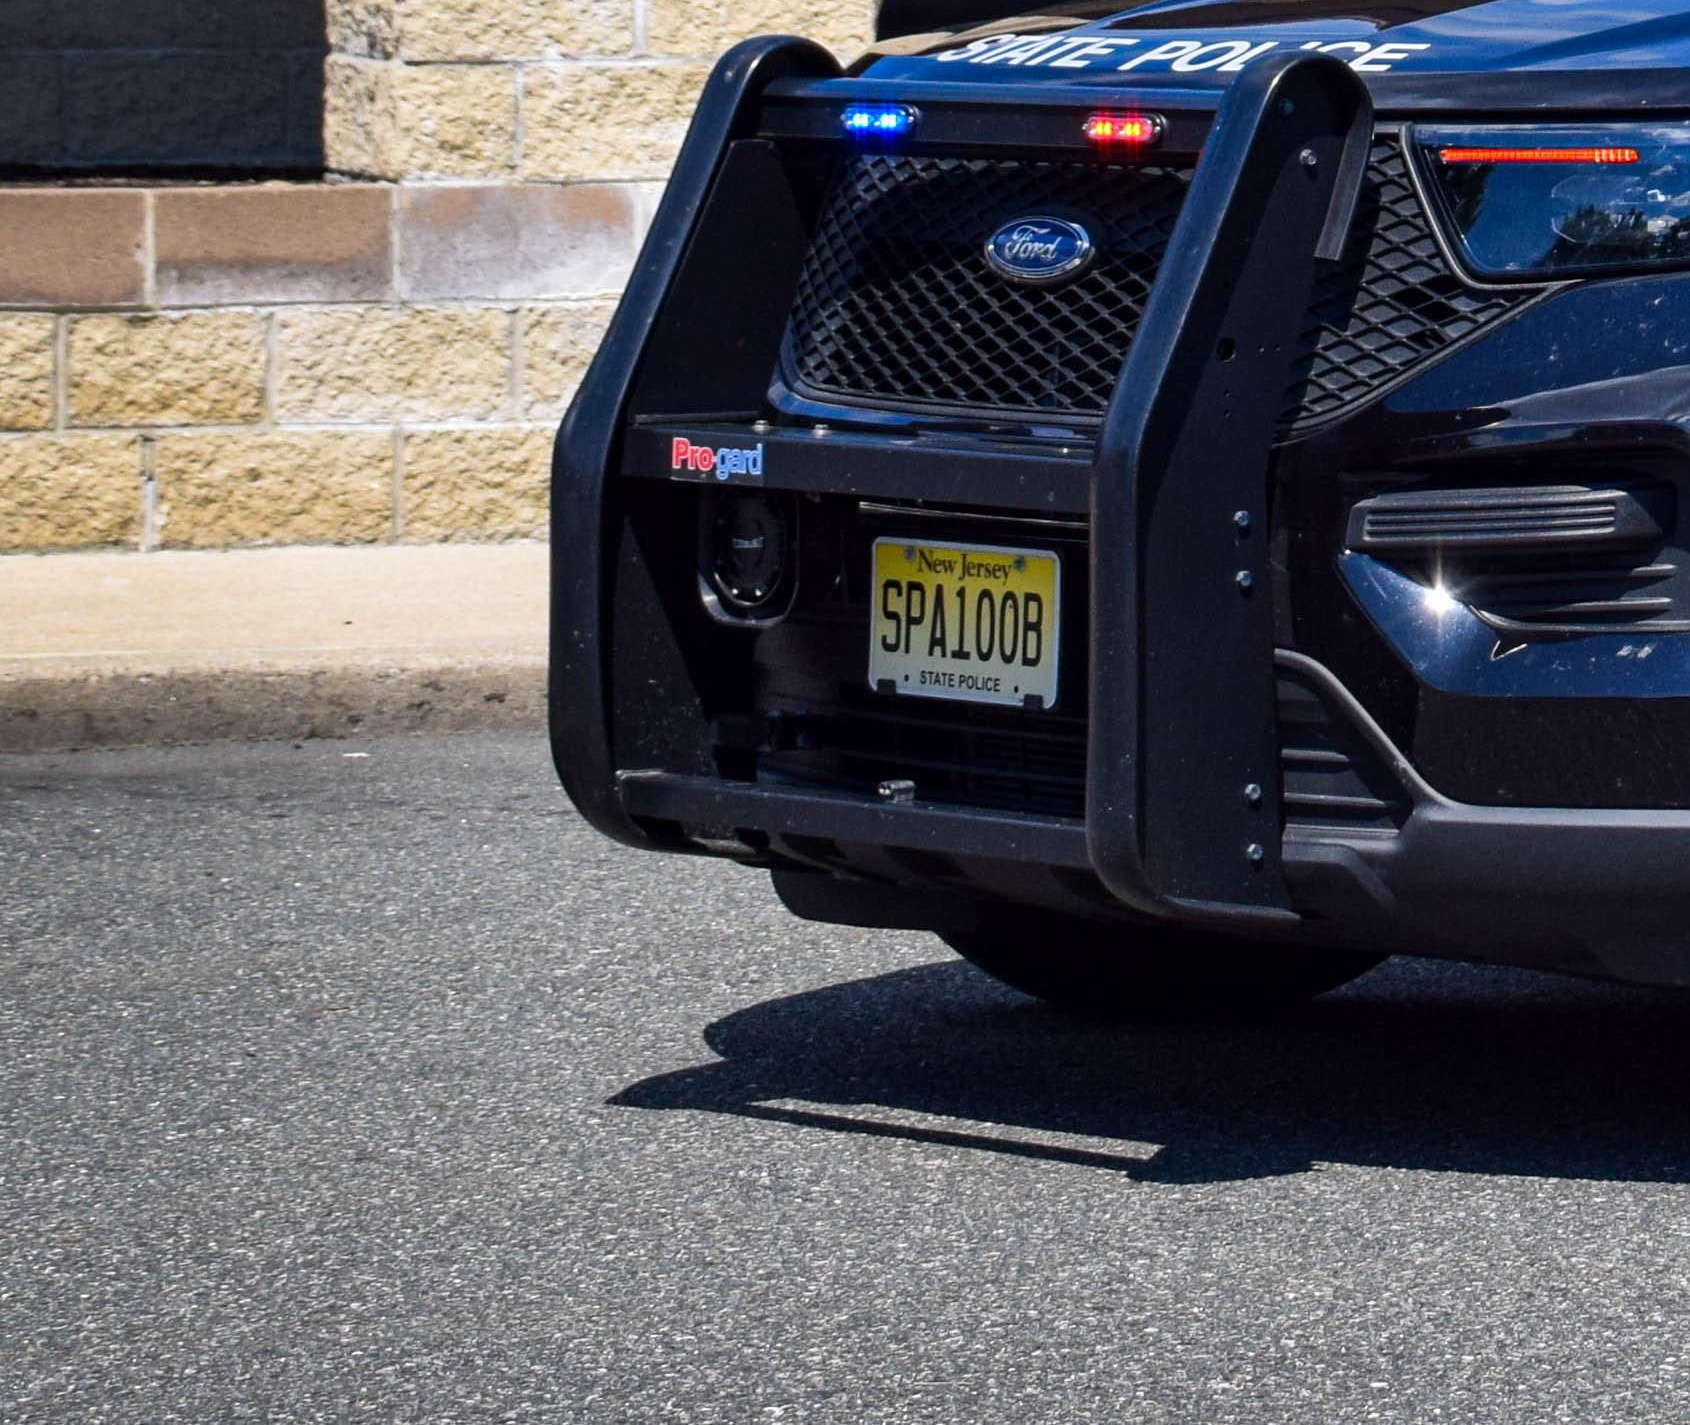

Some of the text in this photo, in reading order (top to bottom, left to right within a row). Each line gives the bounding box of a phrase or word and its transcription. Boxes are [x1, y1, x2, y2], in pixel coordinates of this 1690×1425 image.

[937, 33, 1432, 72] STATE POLCE
[1005, 224, 1063, 261] Ford
[671, 437, 763, 481] Pro-gard
[918, 549, 1014, 586] New Jersey
[880, 578, 1044, 668] SPA100B
[919, 669, 1002, 693] STATE POLICE
